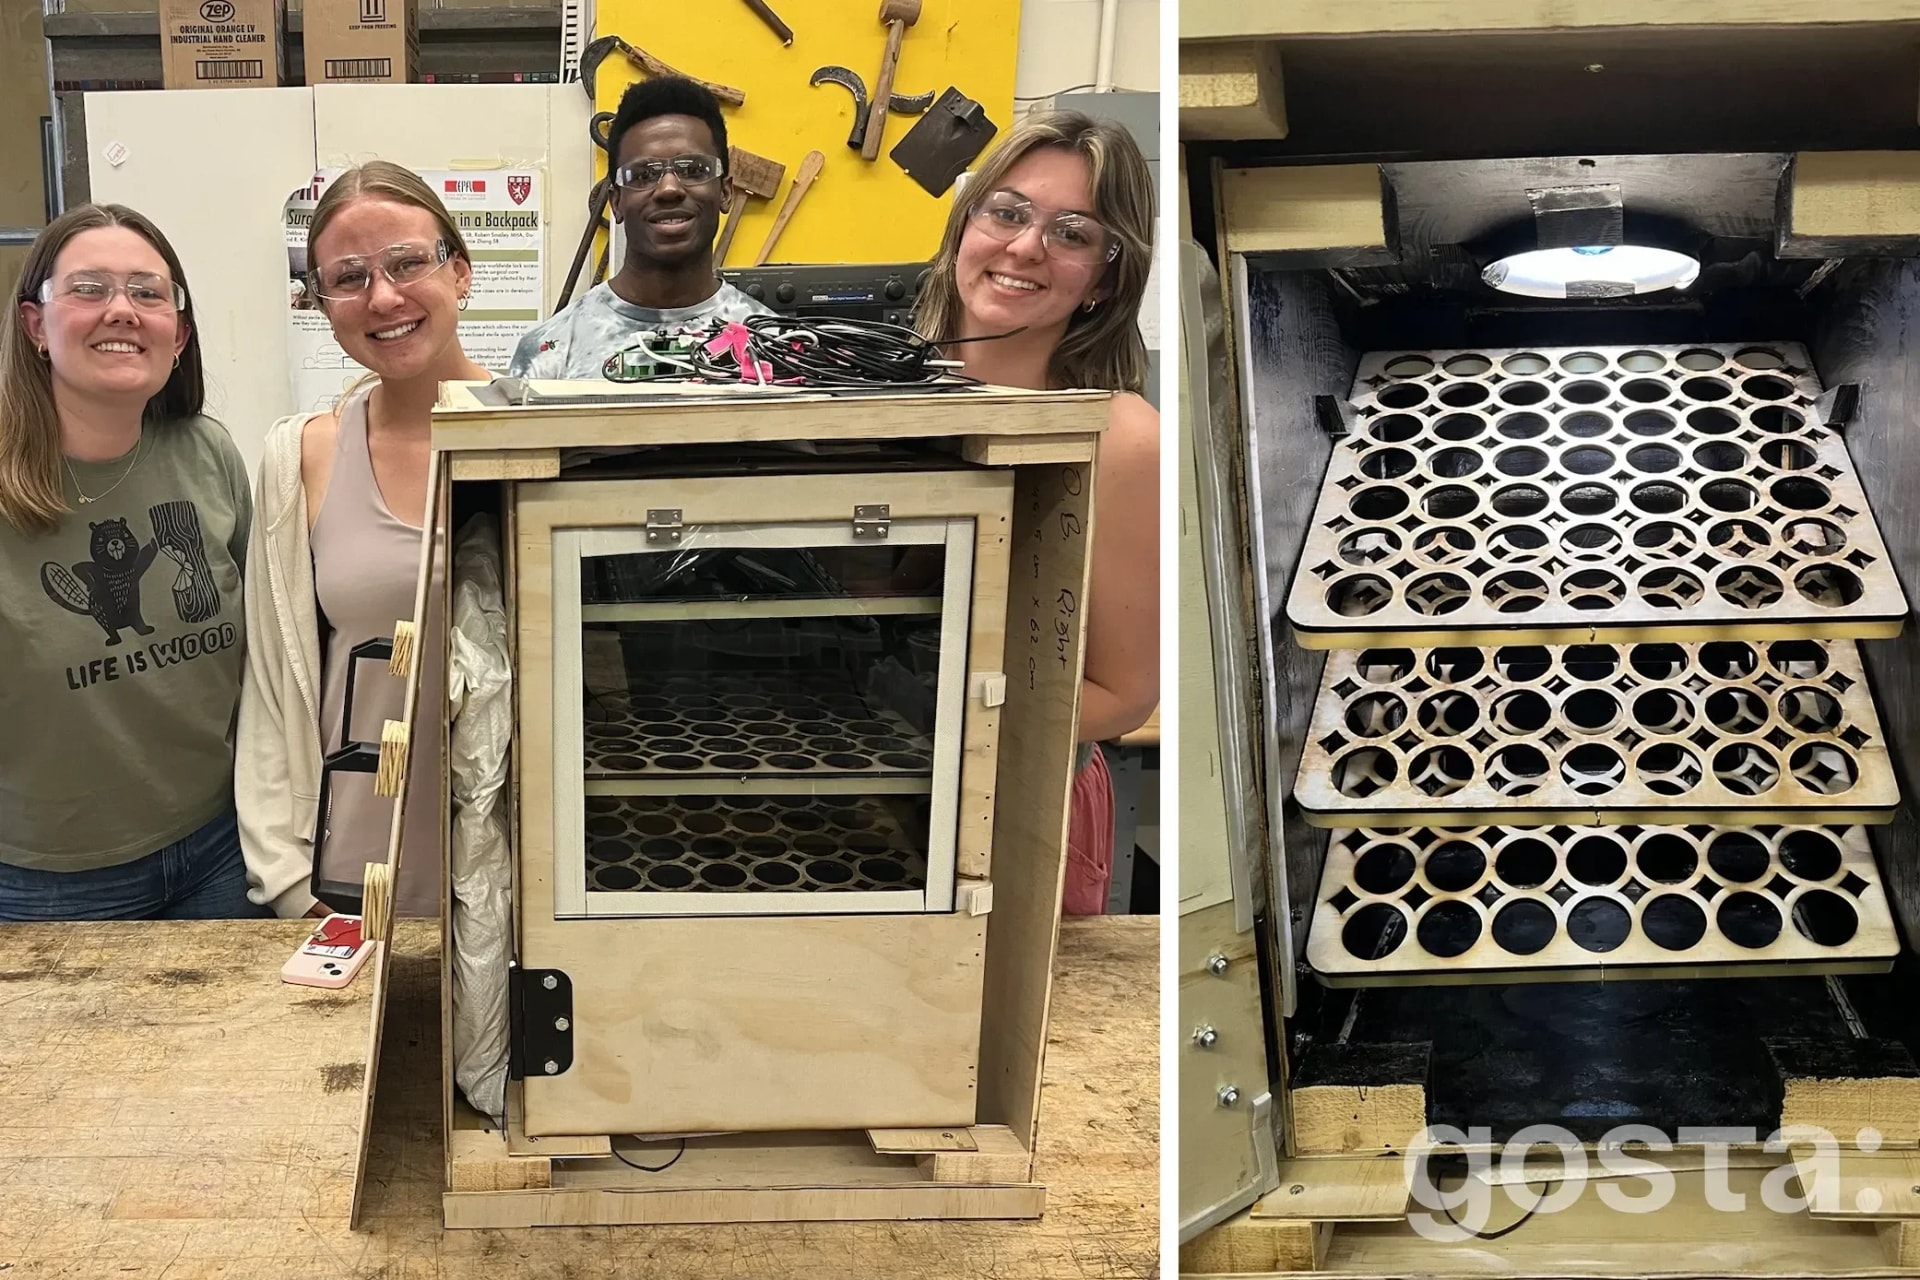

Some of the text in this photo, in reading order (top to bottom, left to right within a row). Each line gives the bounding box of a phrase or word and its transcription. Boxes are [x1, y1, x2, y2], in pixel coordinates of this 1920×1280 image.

[170, 34, 266, 44] INDUSTRIAL HAND CLEANER
[180, 24, 255, 33] ORIGINAL ORANGE LV
[460, 212, 470, 227] in
[474, 215, 481, 227] a
[485, 211, 538, 231] Backpack
[1029, 618, 1040, 645] 62
[1054, 588, 1077, 672] Right
[66, 621, 237, 691] LIFE IS WOOD
[1028, 655, 1036, 691] cm
